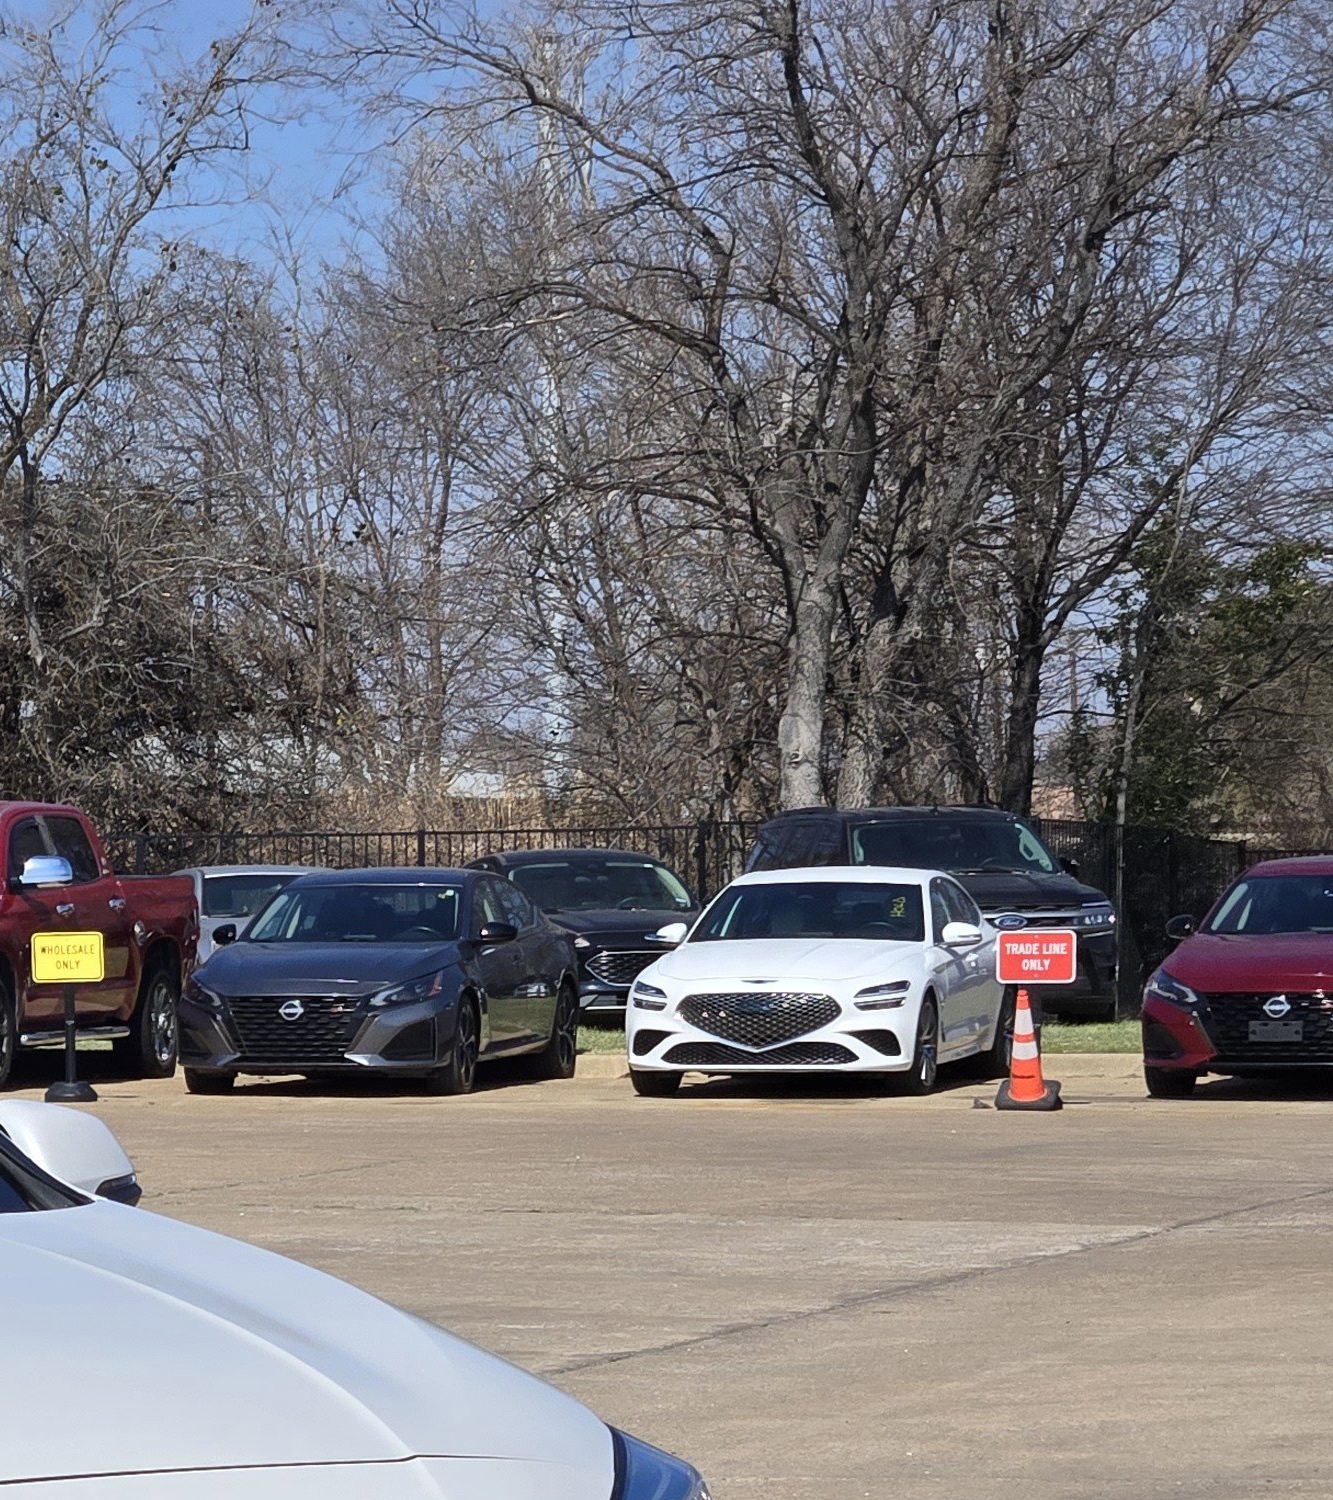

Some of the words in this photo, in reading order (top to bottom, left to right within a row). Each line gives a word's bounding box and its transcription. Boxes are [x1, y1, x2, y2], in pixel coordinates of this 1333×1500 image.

[40, 943, 95, 955] WHOLESALE
[1005, 943, 1039, 955] TRADE
[1042, 943, 1067, 955] LINE
[55, 960, 80, 970] ONLY
[1021, 958, 1051, 971] ONLY
